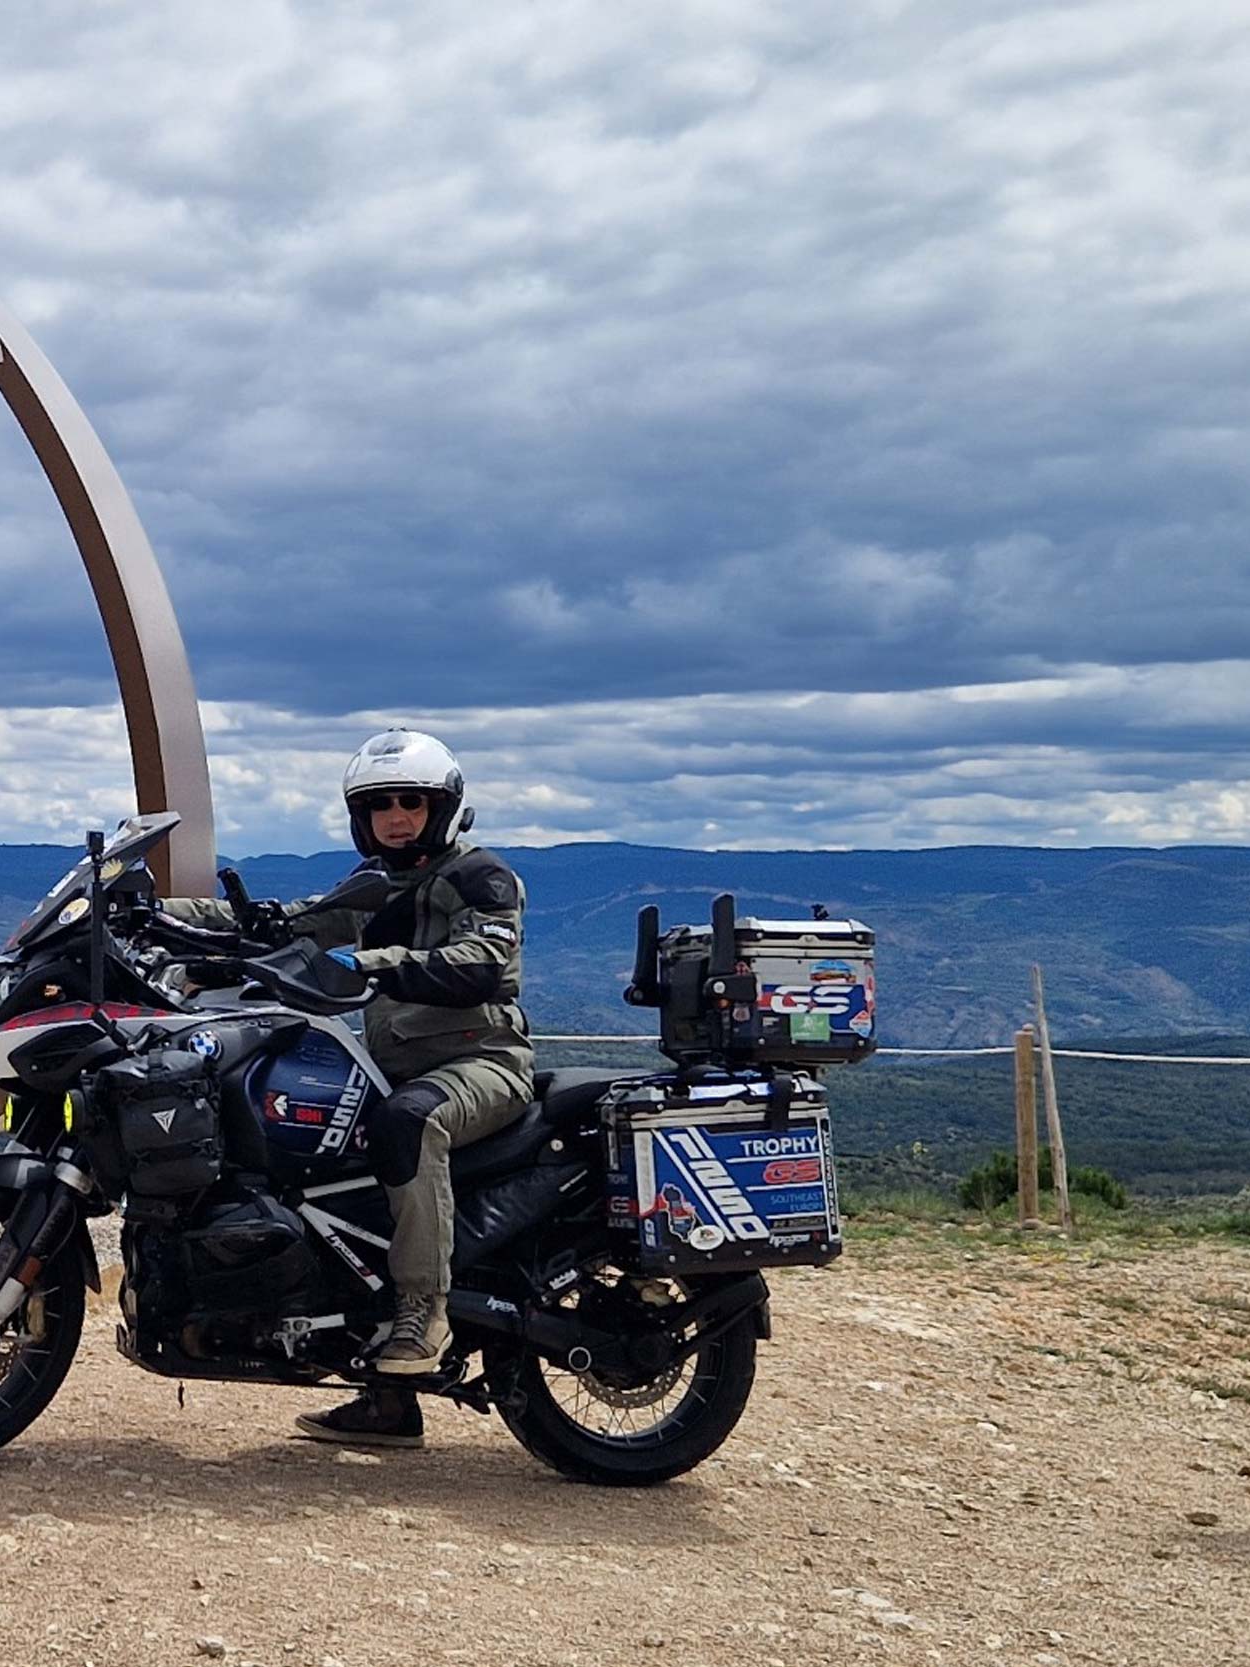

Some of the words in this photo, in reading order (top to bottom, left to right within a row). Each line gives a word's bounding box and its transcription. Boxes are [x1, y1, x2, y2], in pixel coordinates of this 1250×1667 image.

[770, 985, 852, 1014] GS
[740, 1135, 818, 1156] TROPHY
[763, 1159, 820, 1184] GS
[668, 1133, 770, 1239] 1250
